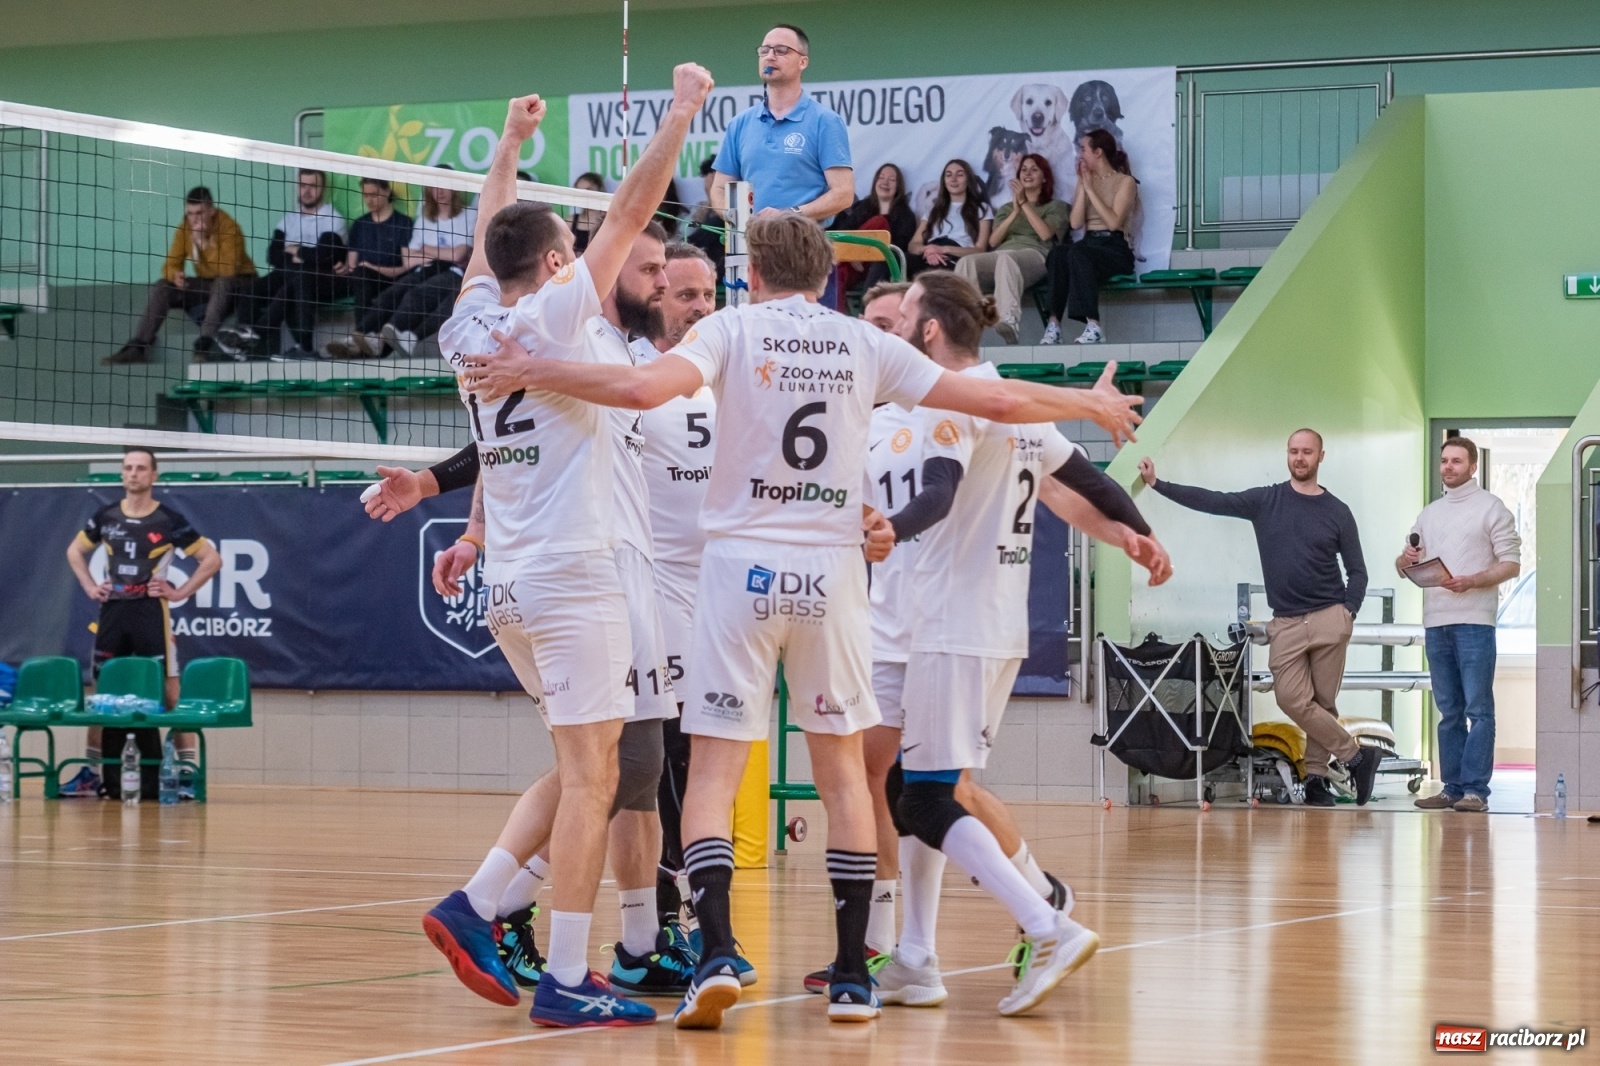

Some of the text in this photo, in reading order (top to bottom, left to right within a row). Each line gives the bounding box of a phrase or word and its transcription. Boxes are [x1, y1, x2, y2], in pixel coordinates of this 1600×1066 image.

[763, 337, 851, 356] SKORUPA
[779, 382, 854, 395] LUNATYCY
[686, 412, 711, 449] 5
[782, 401, 828, 471] 6
[667, 466, 713, 483] Tropi
[878, 468, 917, 509] 11
[750, 478, 847, 508] TropiDog
[1012, 468, 1035, 534] 2
[124, 541, 136, 559] 4
[492, 580, 518, 606] DK
[780, 571, 827, 598] DK
[753, 592, 827, 620] glass
[485, 606, 523, 636] glass
